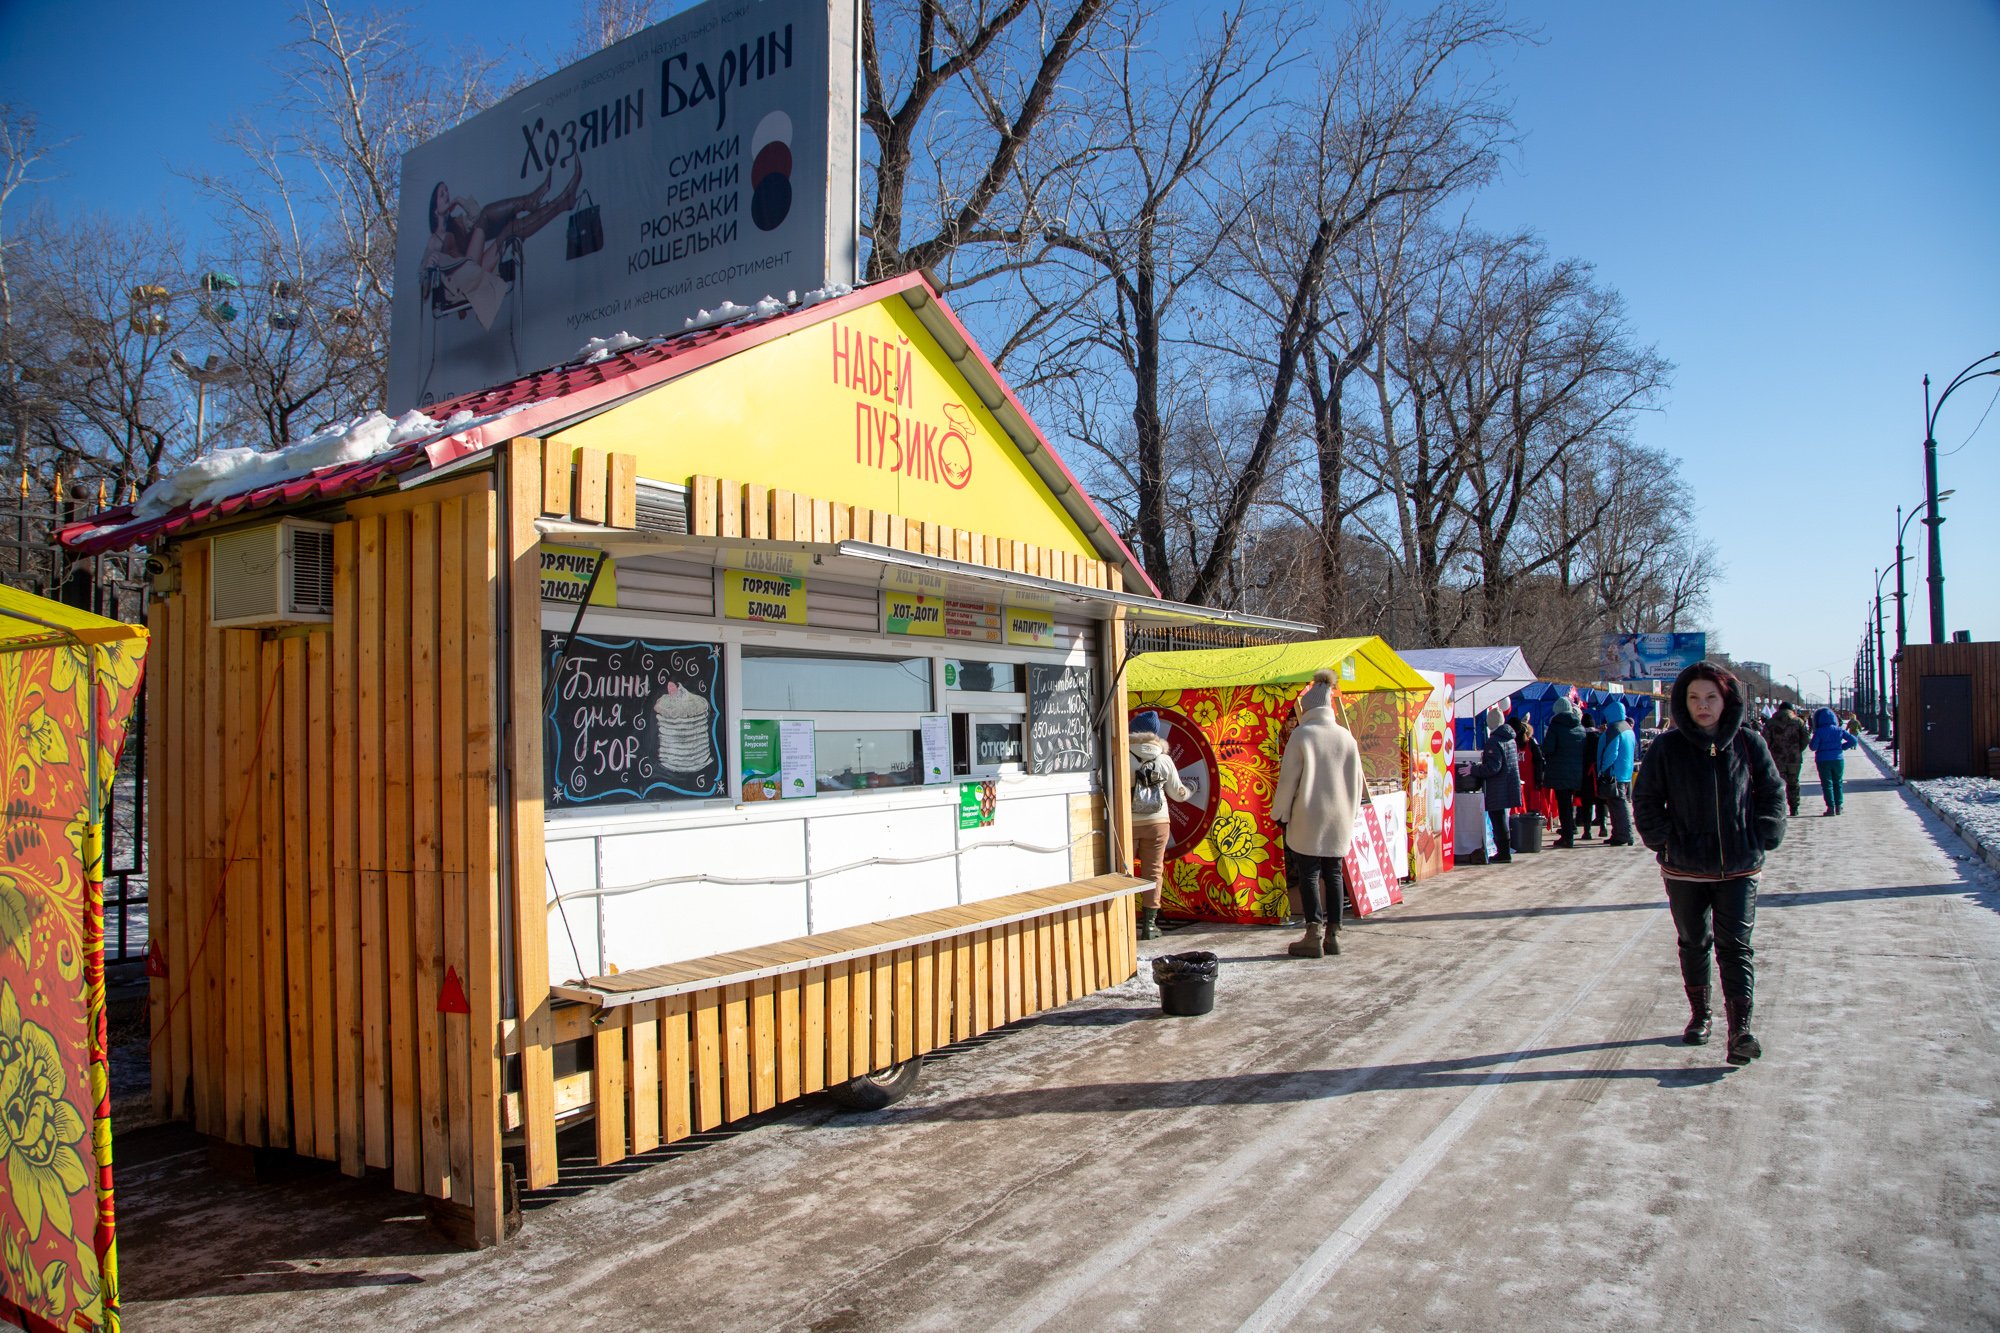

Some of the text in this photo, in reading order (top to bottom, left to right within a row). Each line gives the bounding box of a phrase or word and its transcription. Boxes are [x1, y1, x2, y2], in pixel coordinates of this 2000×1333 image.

[651, 18, 718, 55] натуральной
[721, 6, 749, 25] кожи
[668, 134, 740, 179] СУМКИ
[667, 163, 740, 207] РЕМНИ
[640, 191, 738, 243] РЮКЗАКИ
[627, 220, 738, 275] КОШЕЛЬКИ
[566, 250, 793, 330] мужской и женский ассортимент
[832, 322, 913, 409] НАБЕЙ
[856, 401, 973, 490] ПУЗИКО
[541, 553, 594, 573] РЯЧИЕ
[742, 577, 791, 597] ГОРЯЧИЕ
[748, 601, 787, 620] БЛЮДА
[892, 602, 939, 623] ХОТ-ДОГИ
[1012, 619, 1048, 636] НАПИТКИ
[563, 656, 651, 701] Блины
[573, 703, 627, 762] дня
